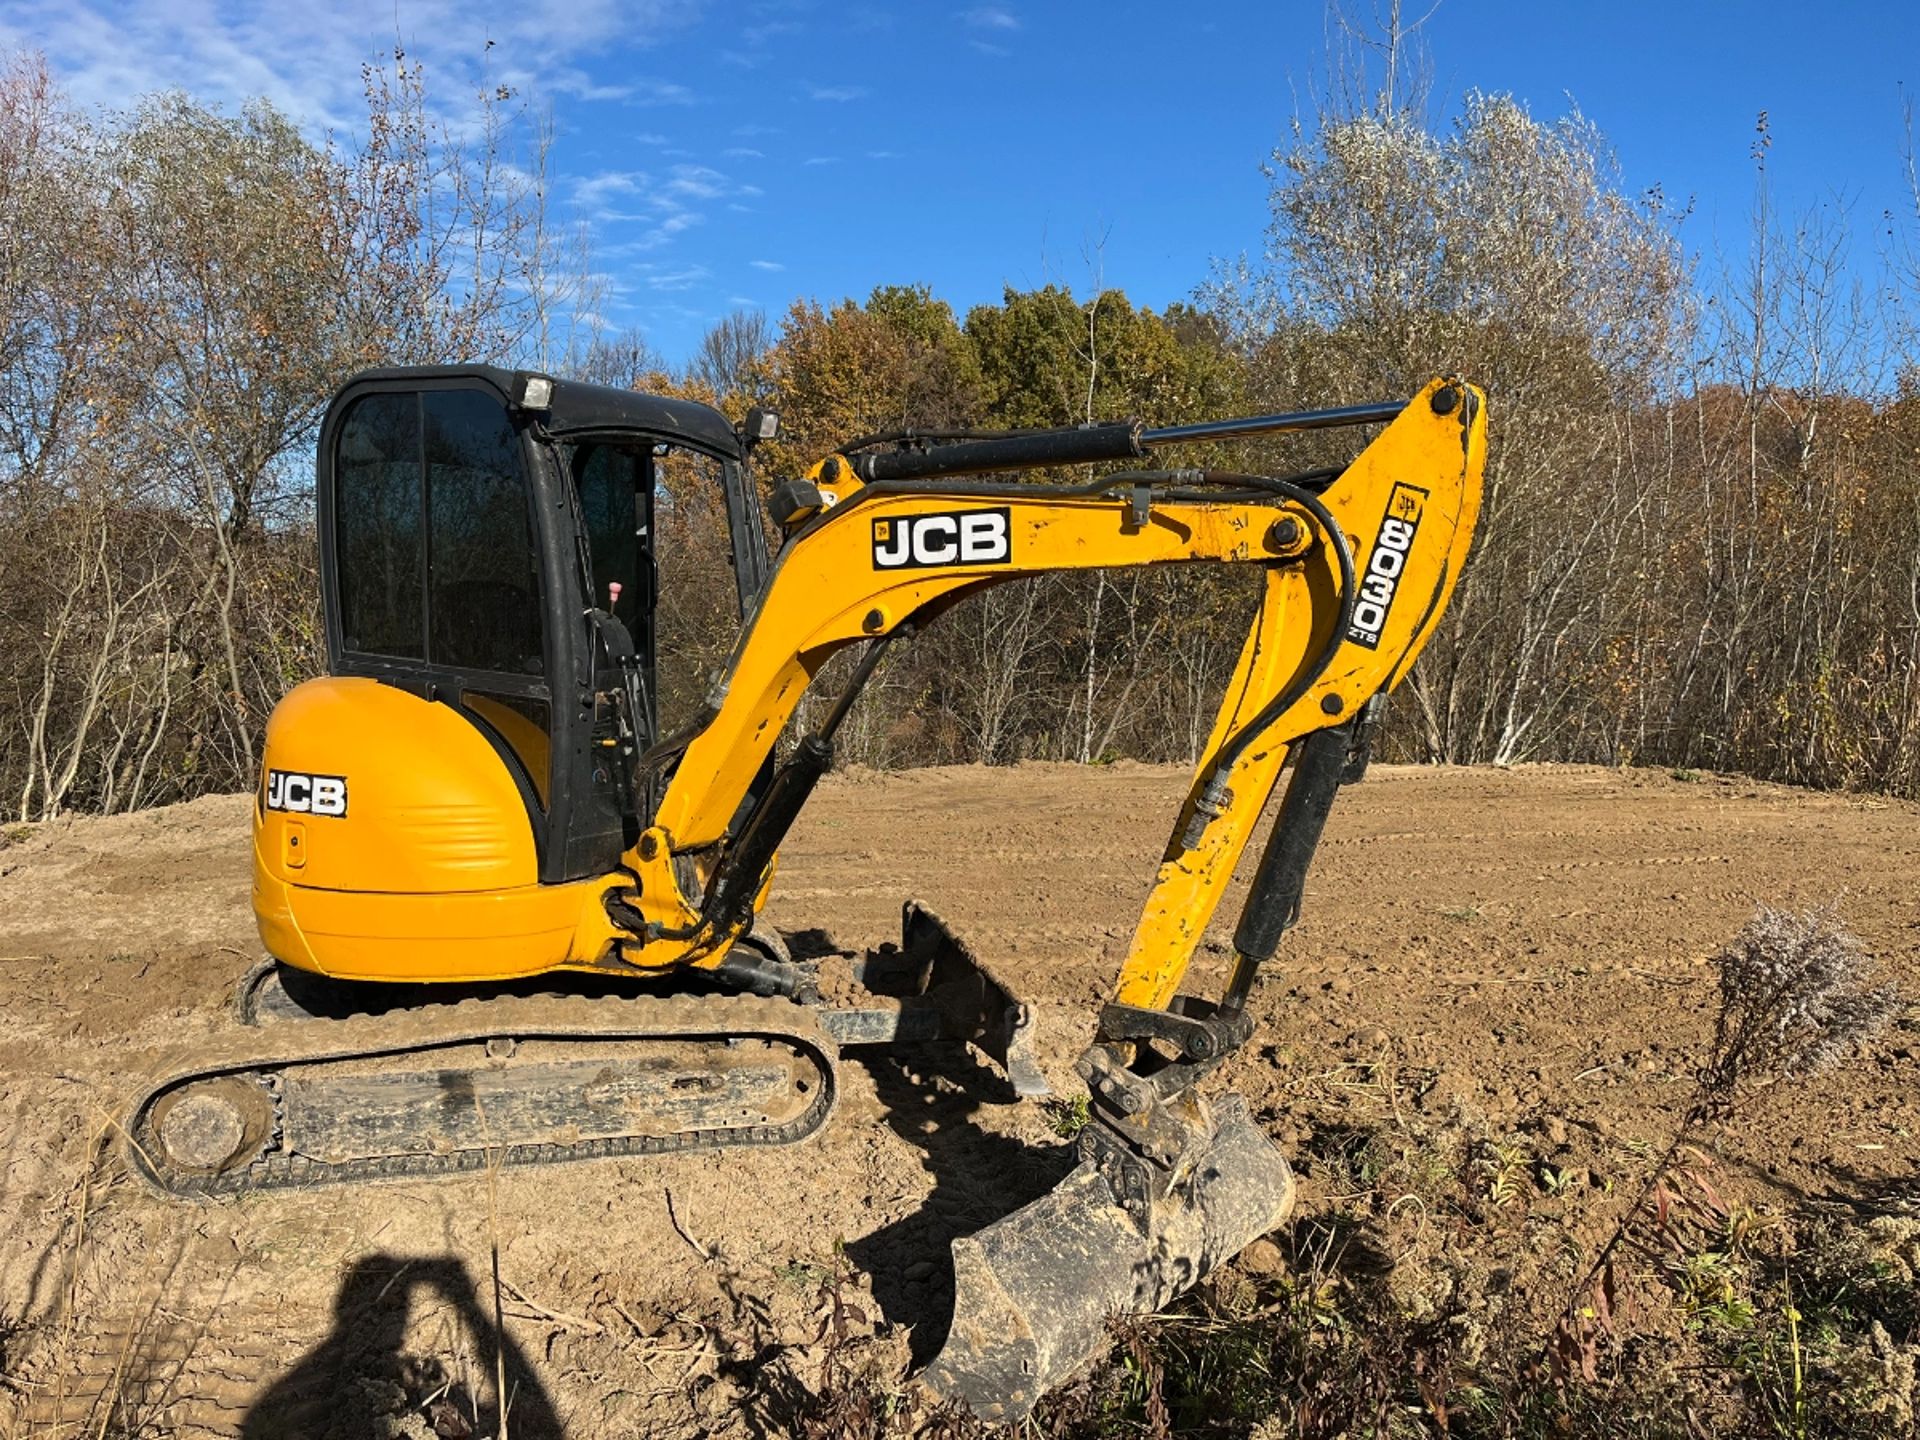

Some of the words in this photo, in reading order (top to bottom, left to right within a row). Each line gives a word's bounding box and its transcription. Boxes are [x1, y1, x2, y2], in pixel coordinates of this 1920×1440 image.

[875, 513, 1007, 566] JCB
[1352, 518, 1414, 632] 8030
[1348, 626, 1377, 643] ZTS
[268, 774, 345, 815] JCB
